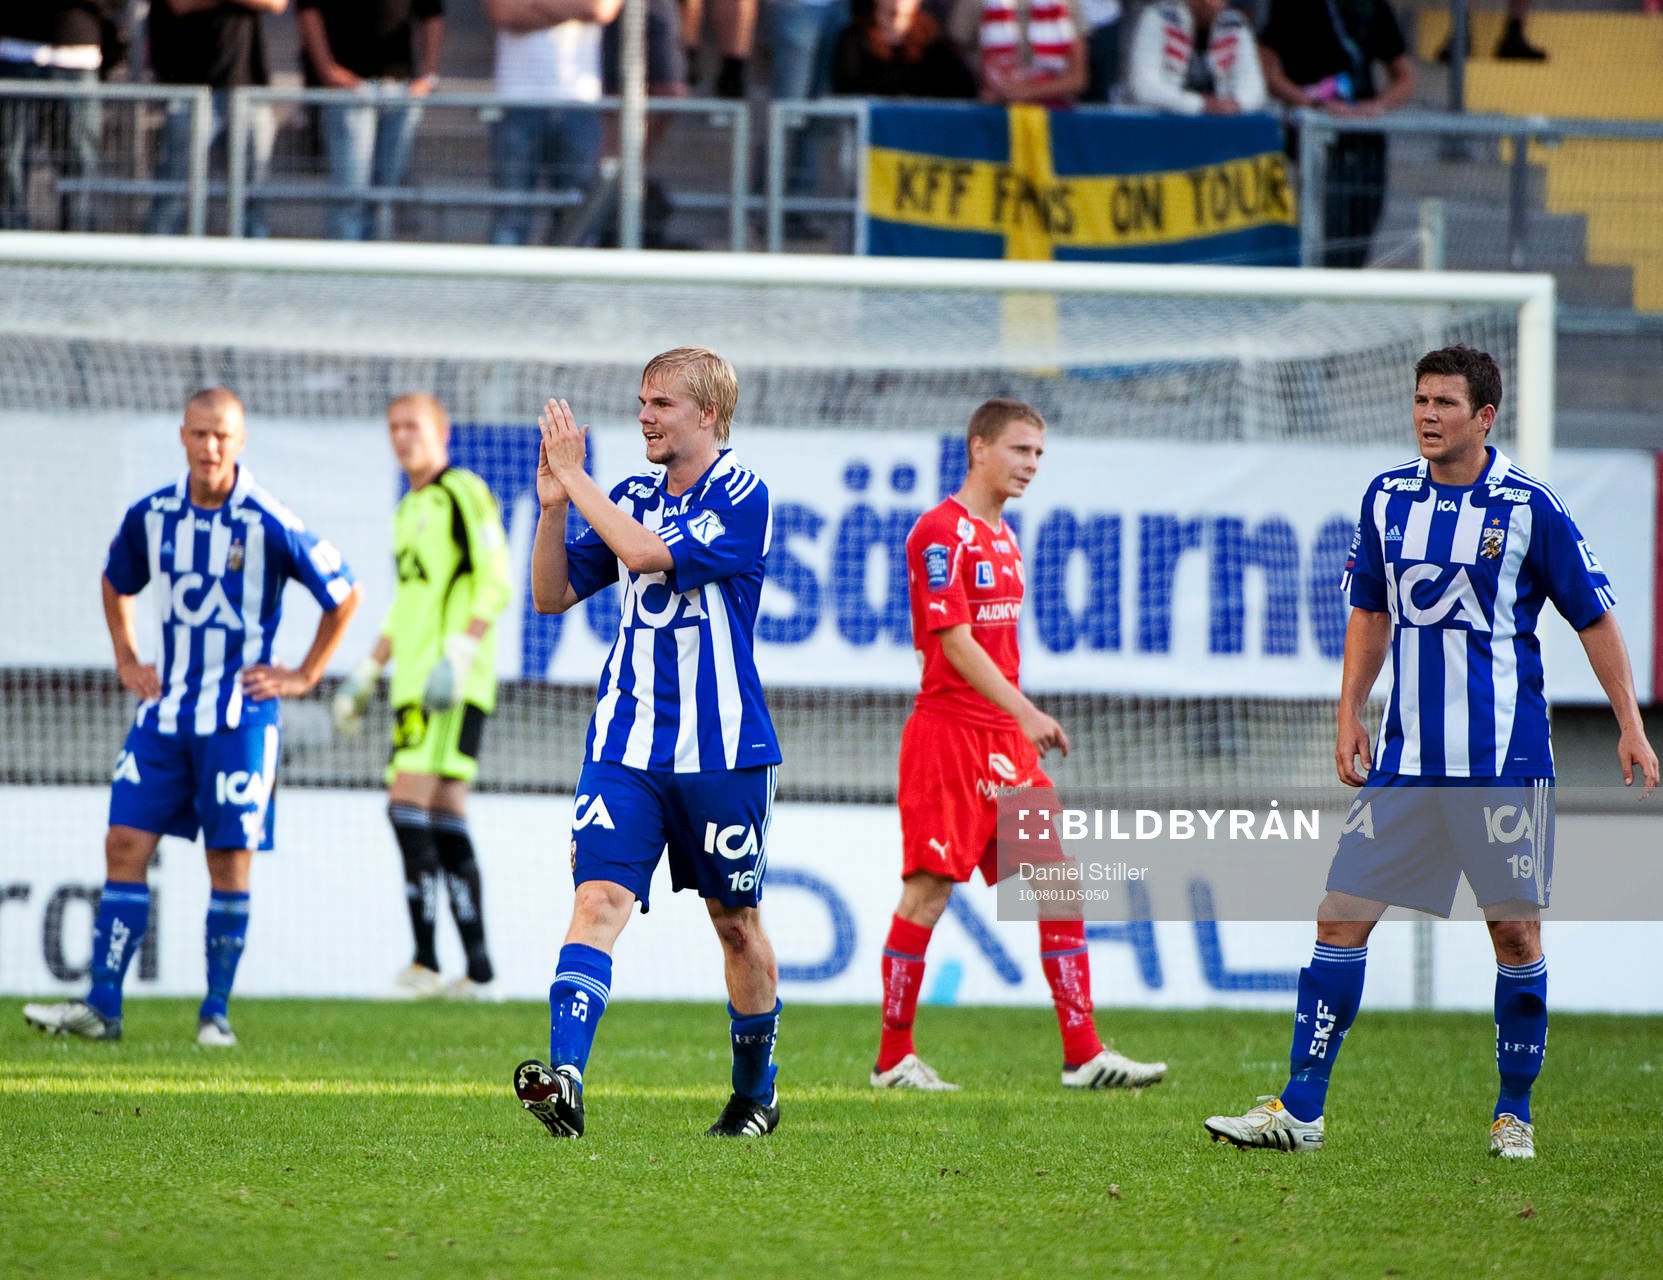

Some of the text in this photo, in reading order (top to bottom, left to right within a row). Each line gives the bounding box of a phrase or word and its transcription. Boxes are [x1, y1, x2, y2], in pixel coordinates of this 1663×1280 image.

[896, 160, 971, 218] KFF
[1111, 177, 1165, 234] ON
[1437, 499, 1458, 512] ICA
[1386, 562, 1492, 633] ICA
[704, 821, 759, 860] ICA
[728, 870, 756, 892] 16
[1506, 854, 1533, 879] 19
[1309, 999, 1337, 1059] SKF
